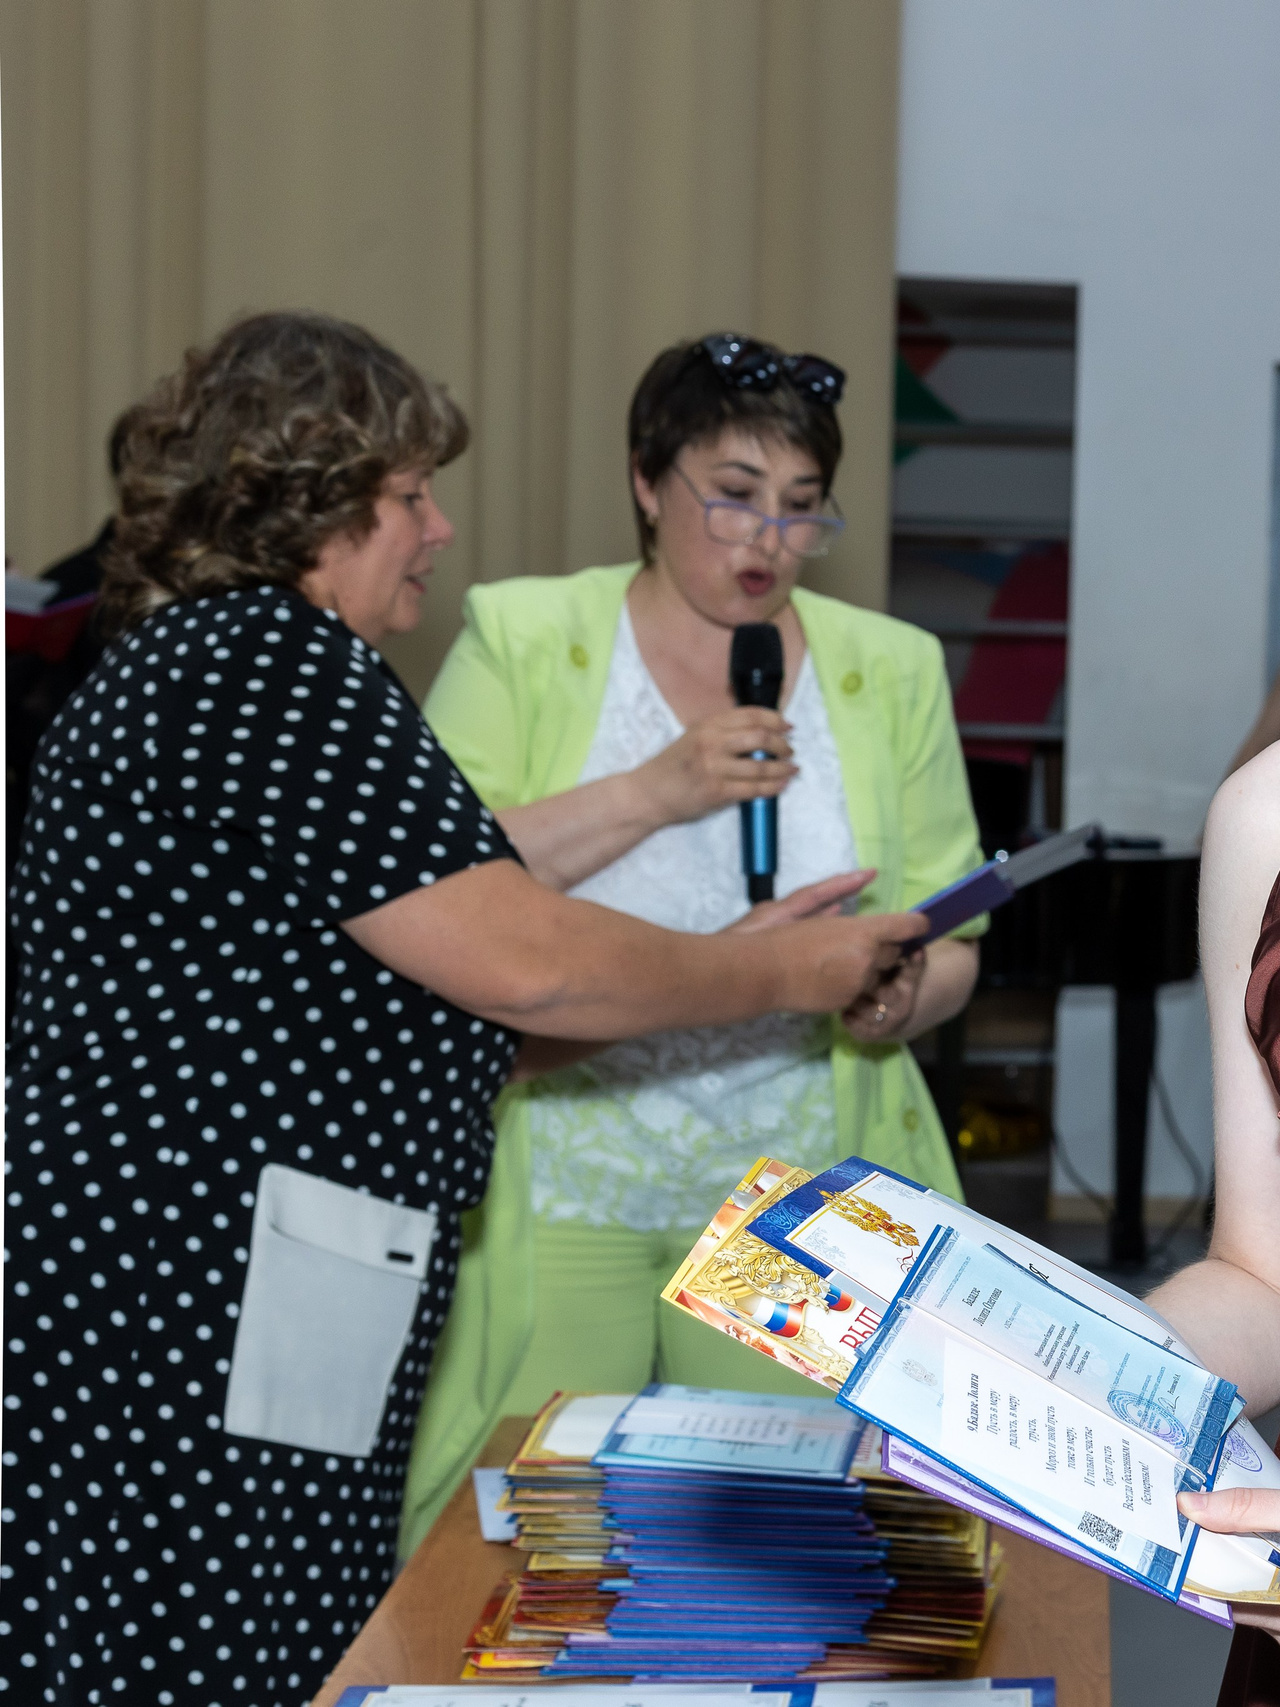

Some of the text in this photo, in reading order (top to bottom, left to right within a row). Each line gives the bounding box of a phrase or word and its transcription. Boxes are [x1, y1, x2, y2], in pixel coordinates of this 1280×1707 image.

[990, 1389, 1001, 1407] меру
[1009, 1394, 1020, 1412] меру
[986, 1413, 1000, 1435] Пусть
[1047, 1406, 1058, 1425] пусть
[1045, 1424, 1056, 1442] зной
[1046, 1448, 1059, 1473] Мороз
[1067, 1451, 1075, 1469] тоже
[1084, 1426, 1095, 1487] И только счастье
[1103, 1446, 1116, 1486] будет пусть
[1121, 1438, 1134, 1511] Всегда бесценным и
[1139, 1461, 1153, 1505] безмерным!
